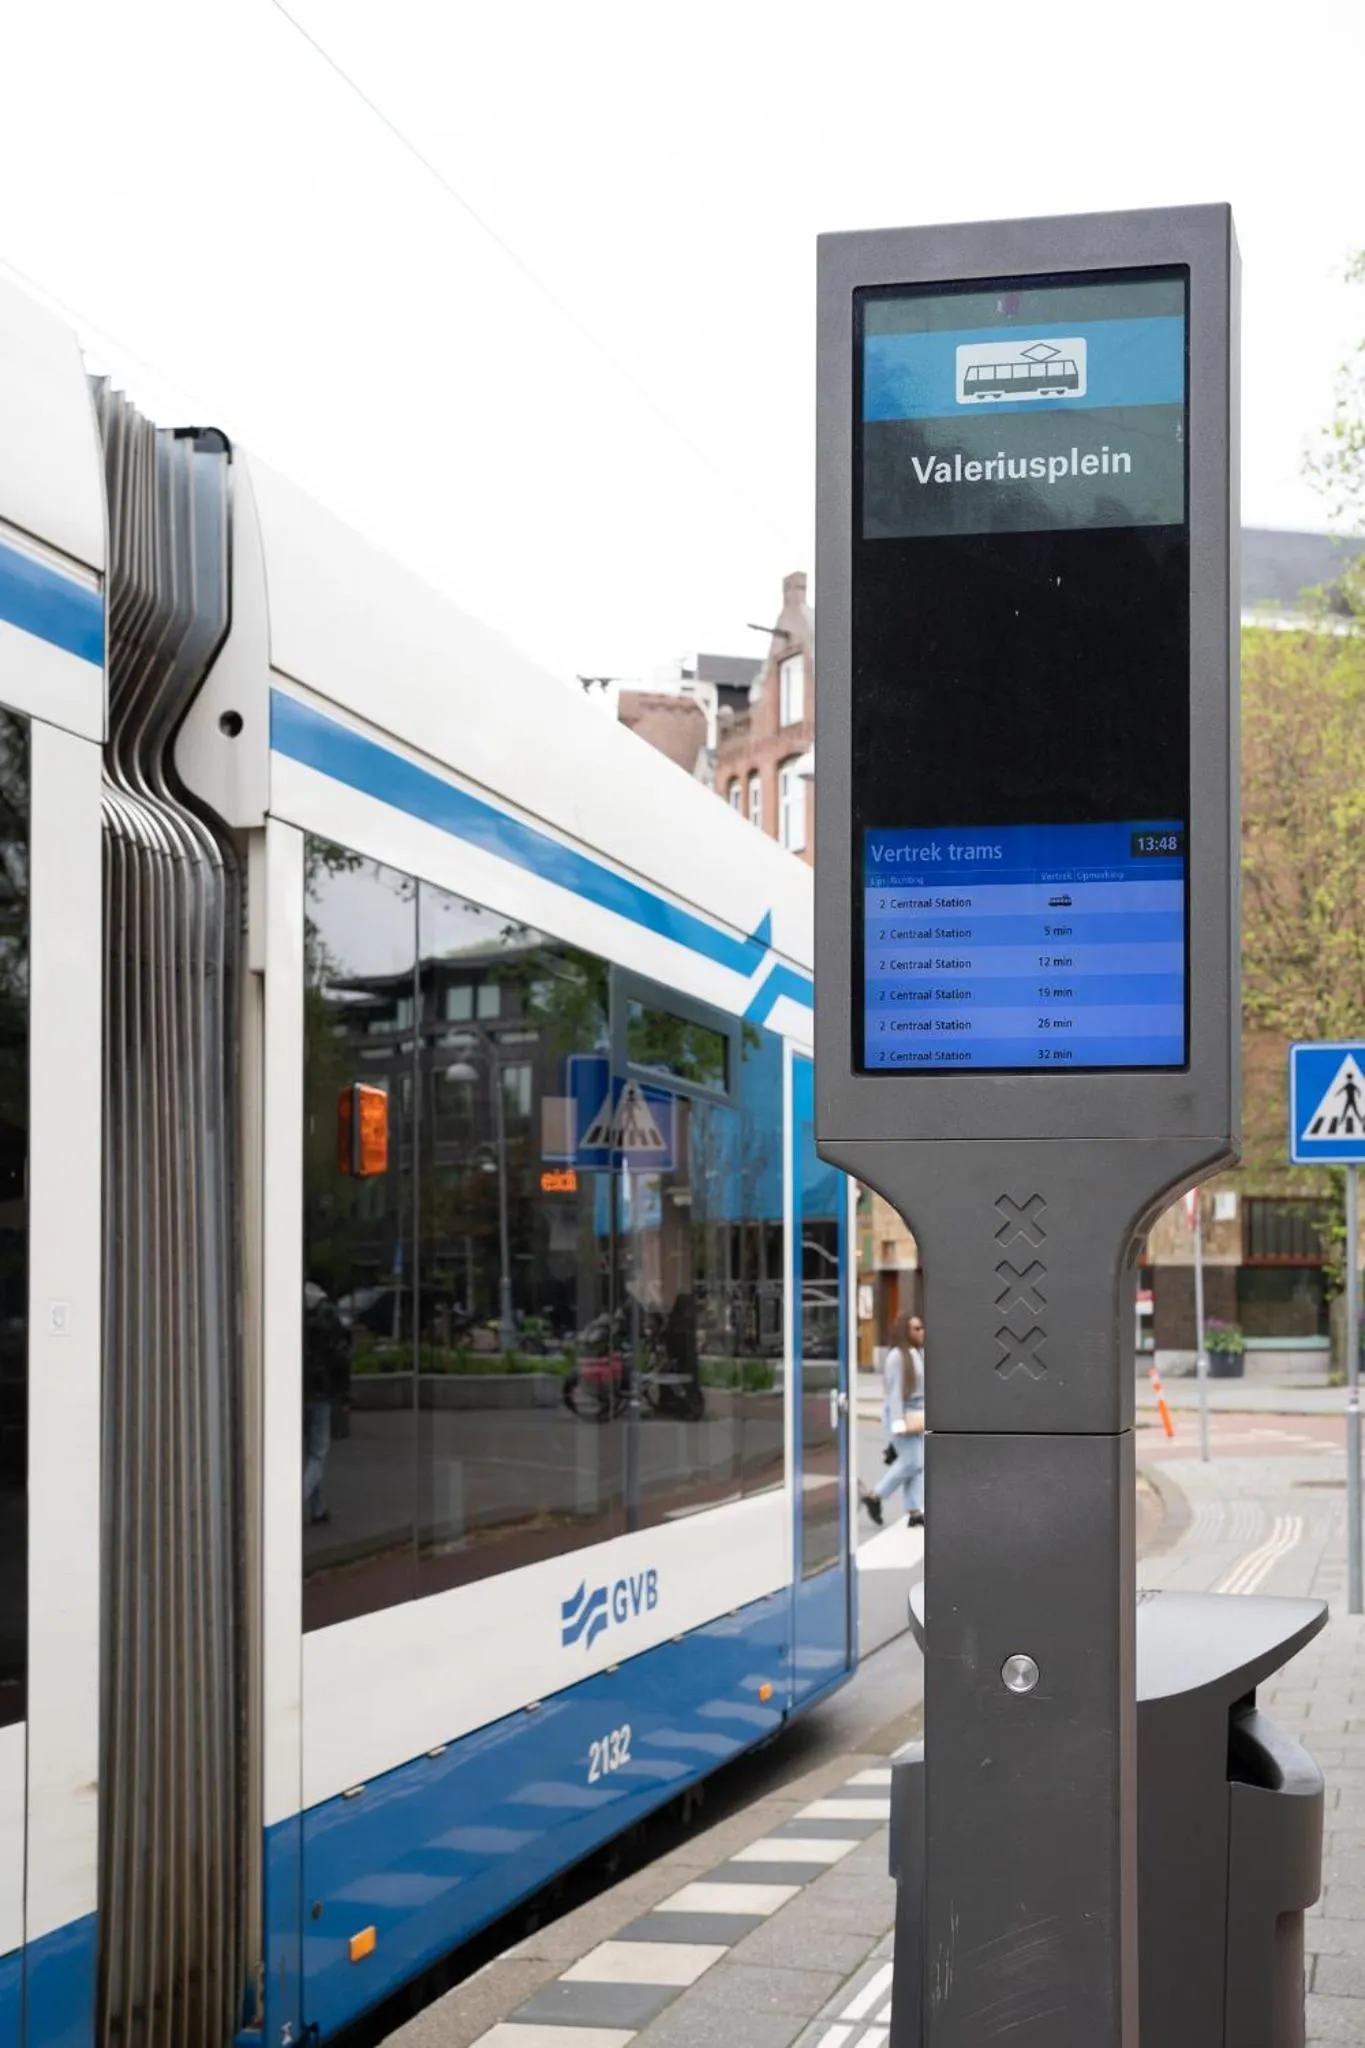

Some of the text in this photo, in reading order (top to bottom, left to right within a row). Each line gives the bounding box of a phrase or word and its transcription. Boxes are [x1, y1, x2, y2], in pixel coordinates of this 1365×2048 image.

[912, 446, 1132, 484] Valeriusplein
[1137, 835, 1178, 852] 13:48
[871, 843, 1002, 864] Vertrek trams
[879, 897, 971, 909] 2 Centraal Station
[879, 928, 971, 940] 2 Centraal Station
[1044, 925, 1072, 936] 5 min
[879, 958, 971, 971] 2 Centraal Station
[1039, 956, 1072, 967] 12 min
[879, 989, 971, 1002] 2 Centraal Station
[1039, 987, 1072, 998] 19 min
[879, 1019, 971, 1032] 2 Centraal Station
[1038, 1018, 1072, 1029] 26 min
[879, 1050, 971, 1063] 2 Centraal Station
[1038, 1048, 1072, 1059] 32 min
[612, 1568, 658, 1624] GVB
[587, 1724, 631, 1785] 2132
